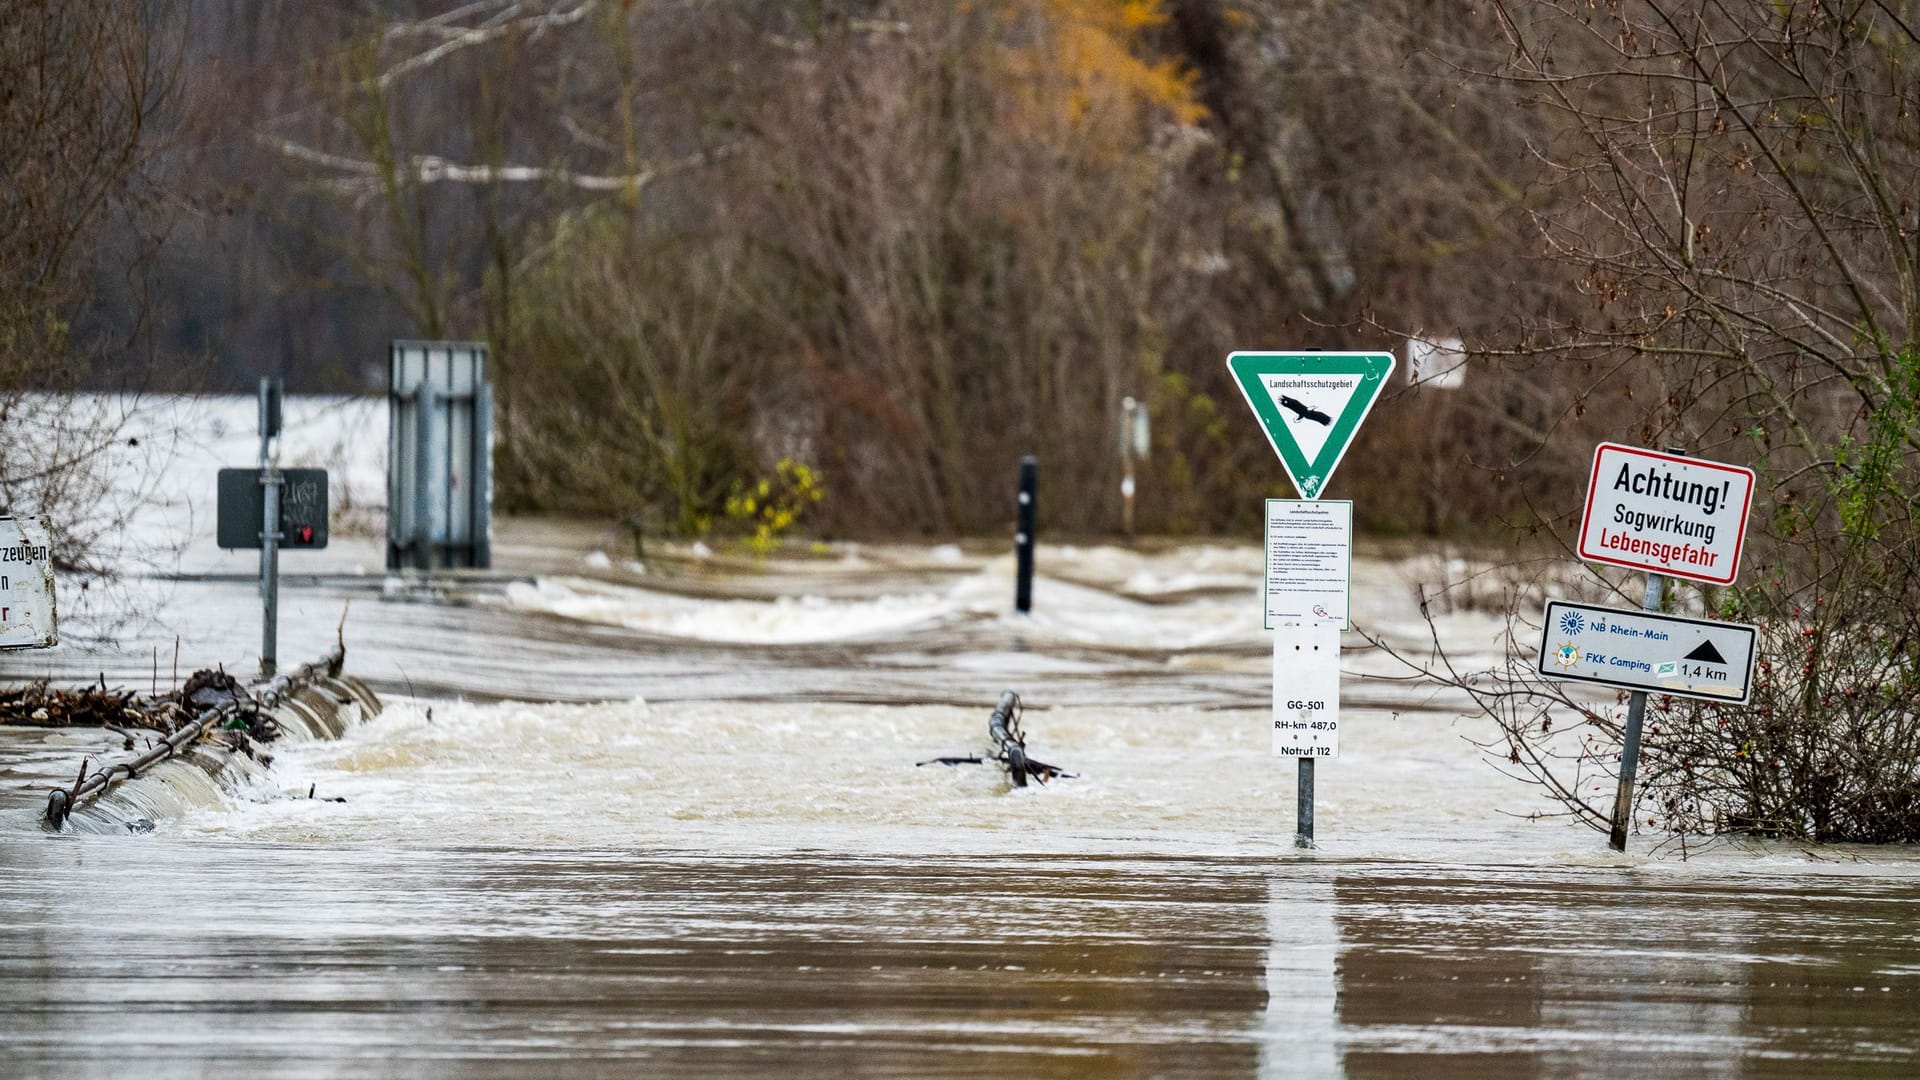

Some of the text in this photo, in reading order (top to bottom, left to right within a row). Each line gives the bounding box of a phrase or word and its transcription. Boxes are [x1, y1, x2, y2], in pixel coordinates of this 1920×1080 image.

[1269, 379, 1353, 391] Landschaftsschutzgebiet
[1613, 462, 1730, 515] Achtung!
[1613, 503, 1716, 545] Sogwirkung
[0, 545, 47, 565] zeugen
[1600, 527, 1719, 567] Lebensgefahr
[1590, 621, 1669, 641] NB Rhein-Main
[1585, 652, 1606, 665] FKK
[1609, 656, 1651, 673] Camping
[1681, 664, 1728, 681] 1,4 km
[1287, 700, 1325, 710] GG-501
[1274, 720, 1337, 732] RH-km 487,0
[1281, 746, 1331, 756] Notruf 112
